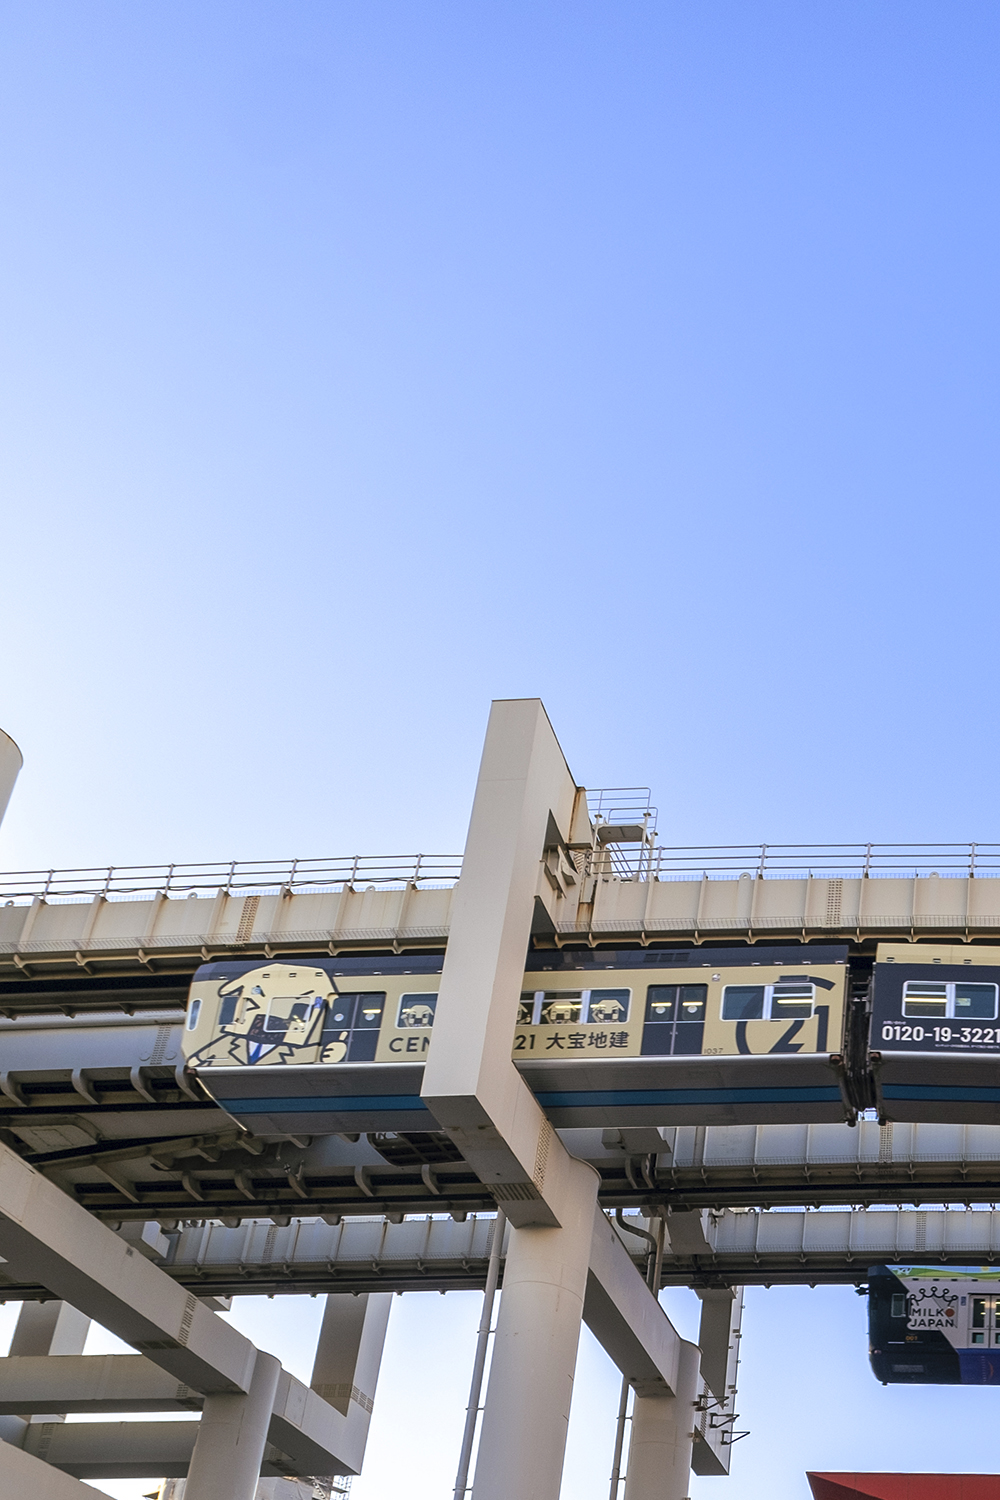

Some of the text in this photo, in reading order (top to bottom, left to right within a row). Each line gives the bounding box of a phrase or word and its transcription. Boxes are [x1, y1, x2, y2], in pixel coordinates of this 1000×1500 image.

[514, 1031, 629, 1049] 21 大宝地建
[912, 1308, 943, 1317] MILK
[910, 1319, 954, 1328] JAPAN
